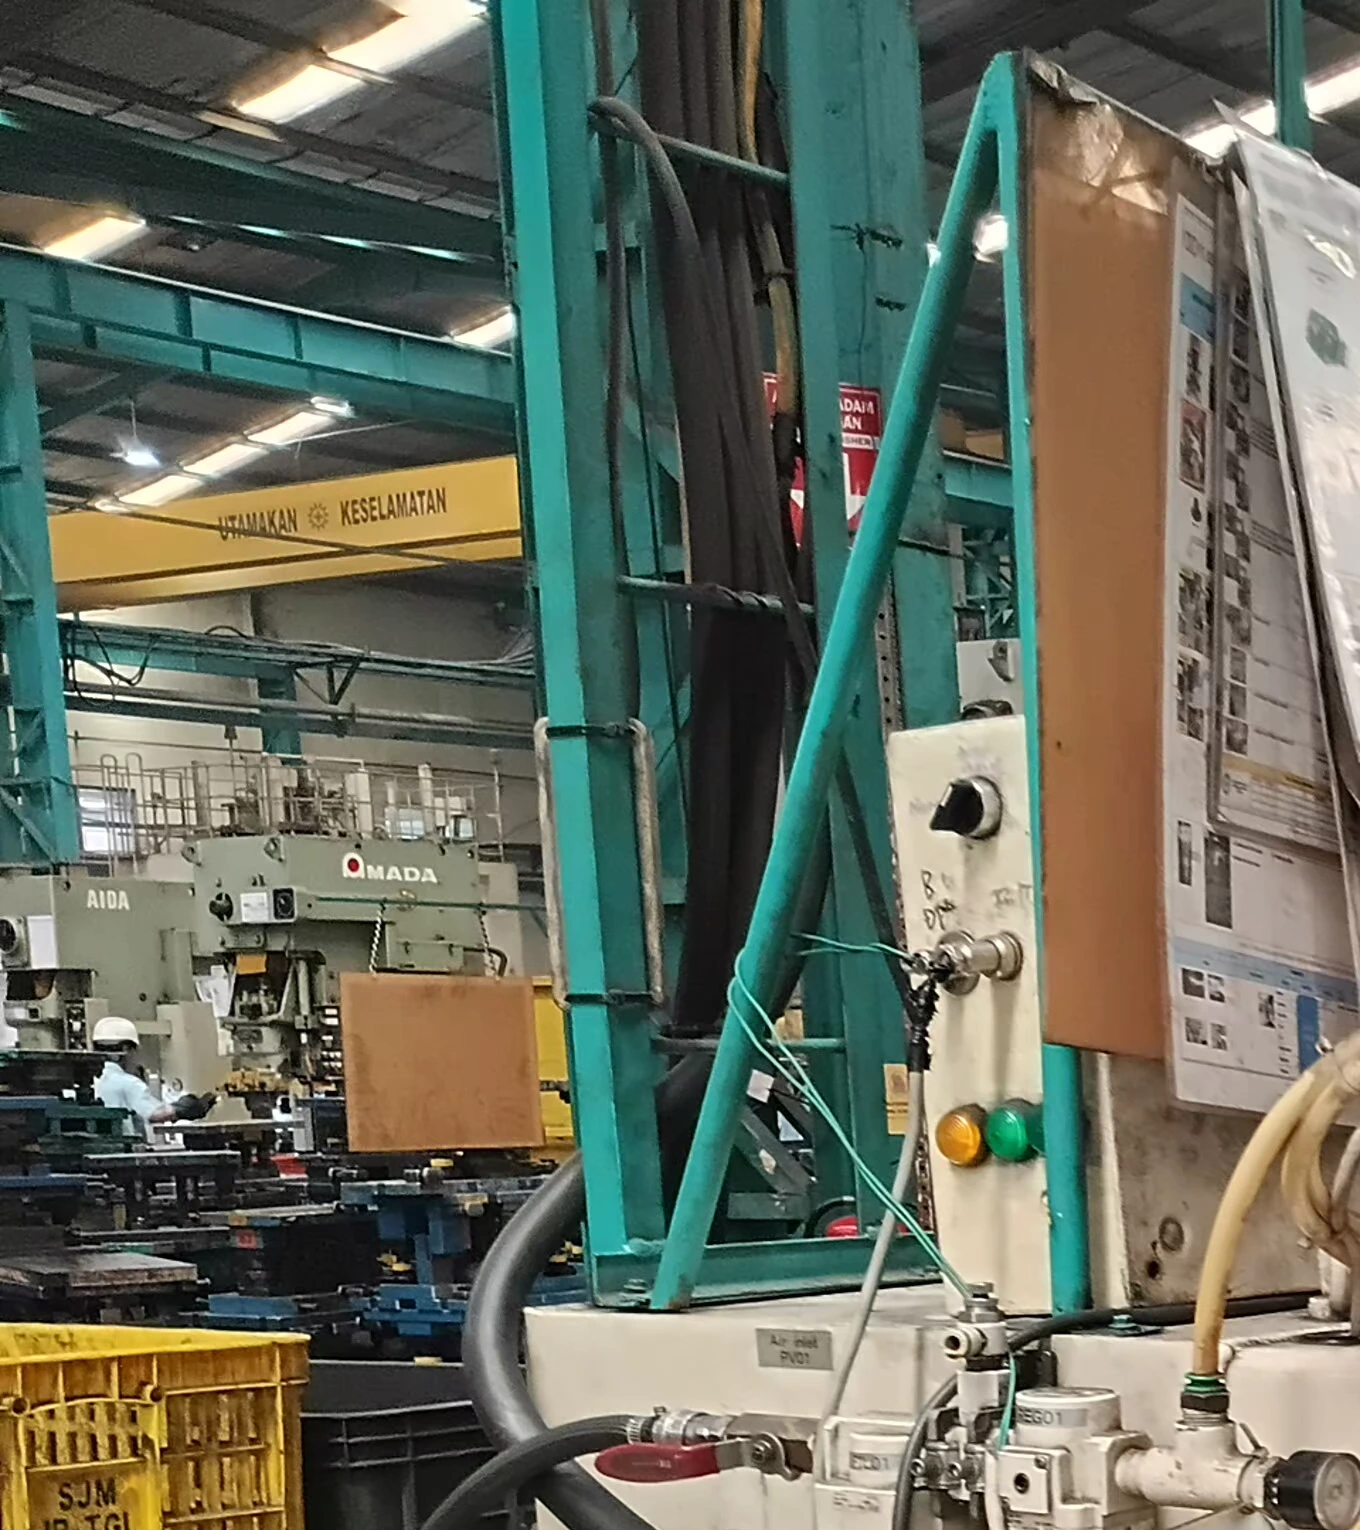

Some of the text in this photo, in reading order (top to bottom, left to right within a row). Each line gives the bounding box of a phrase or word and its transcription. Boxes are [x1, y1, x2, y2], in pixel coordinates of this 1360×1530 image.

[218, 487, 448, 541] UTAMAKAN KESELAMATAN
[87, 889, 130, 911] AIDA
[58, 1477, 118, 1510] SJM
